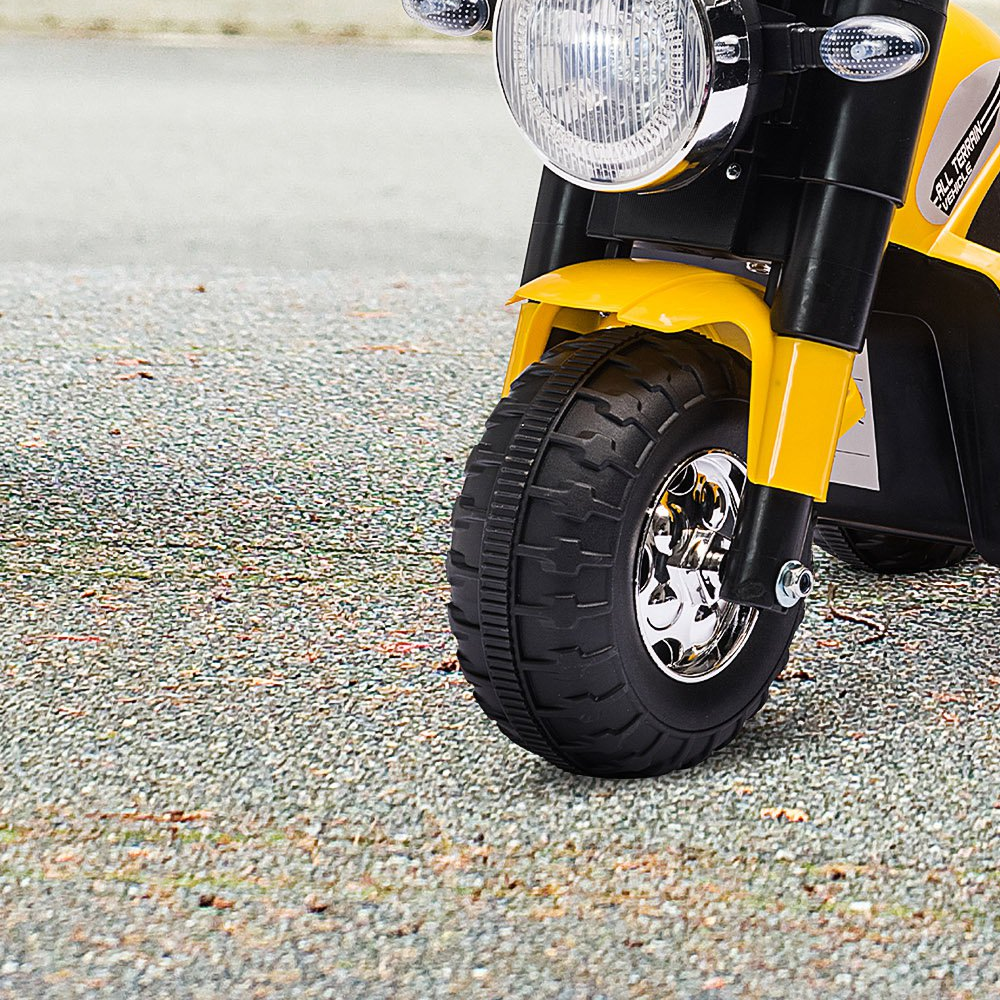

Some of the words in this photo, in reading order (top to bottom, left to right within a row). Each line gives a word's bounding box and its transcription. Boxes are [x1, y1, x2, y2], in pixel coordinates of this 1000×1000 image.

[935, 171, 954, 201] ALL
[951, 120, 984, 175] TERRAIN
[942, 160, 973, 211] VEHICLE
